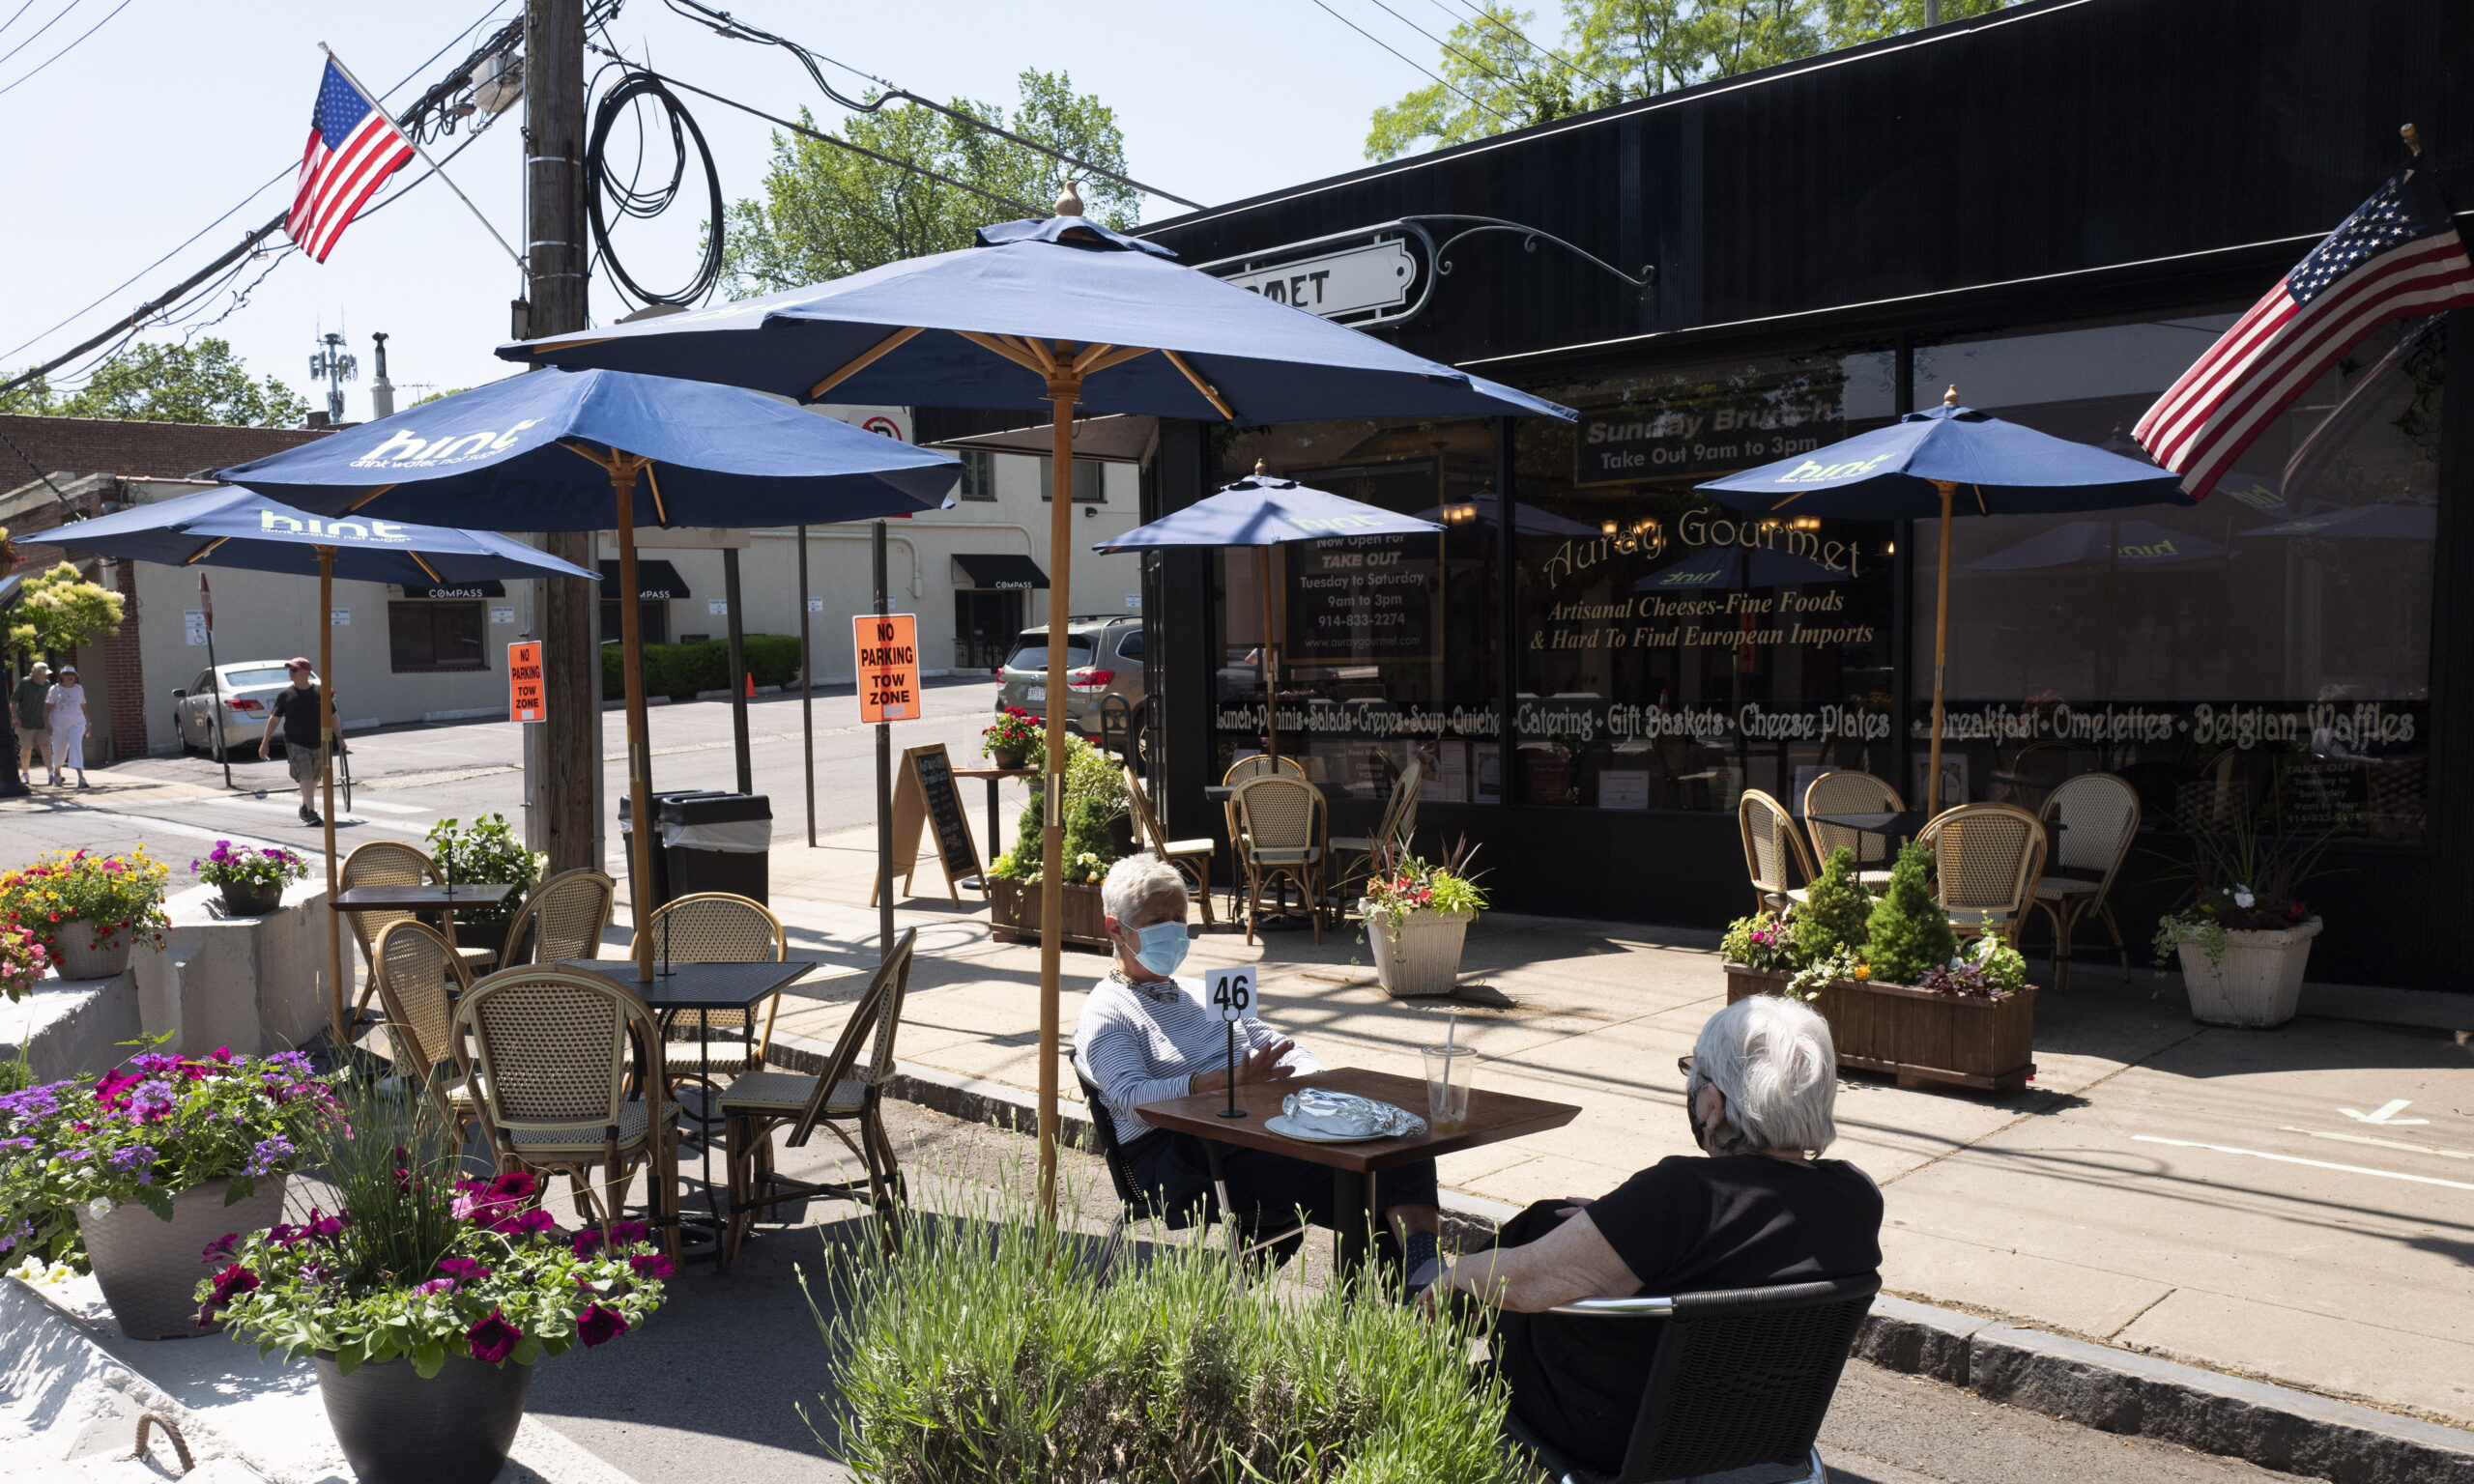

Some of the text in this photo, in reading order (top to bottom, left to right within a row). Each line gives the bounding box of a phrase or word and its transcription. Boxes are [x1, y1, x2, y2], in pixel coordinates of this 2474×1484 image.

[1586, 399, 1833, 443] Sunday Brunch
[360, 417, 545, 461] hint
[1600, 436, 1817, 470] Take Out 9am to 3pm
[1781, 453, 1895, 478] hint
[261, 510, 407, 537] hint
[261, 527, 295, 535] drink
[1289, 515, 1384, 530] hint
[1317, 537, 1344, 548] Now
[1348, 535, 1381, 548] Open
[1543, 507, 1860, 589] Auray Gourmet
[1322, 552, 1401, 568] TAKE OUT
[1300, 571, 1424, 589] Tuesday to Saturday
[429, 588, 483, 598] COMPASS
[1328, 593, 1402, 608] 9am to 3pm
[1547, 598, 1634, 621] Artisanal
[1778, 589, 1845, 613] Foods
[1318, 613, 1405, 627] 914-833-2274
[877, 623, 894, 642] NO
[1530, 622, 1875, 651] & Hard To Find European Imports
[1305, 636, 1421, 649] www.auraygourmet.com
[520, 648, 530, 663] NO
[861, 646, 913, 667] PARKING
[512, 666, 540, 680] PARKING
[872, 673, 905, 688] TOW
[517, 686, 536, 697] TOW
[870, 690, 910, 705] ZONE
[515, 698, 539, 709] ZONE
[1216, 702, 1500, 739] Lunch Pninis Salads Crepes Soup Quiche
[1517, 702, 1890, 742] Catering Gift Baskets Cheese Plates
[2053, 703, 2172, 744] Omelettes
[2194, 702, 2297, 750] Belgian
[2307, 702, 2415, 751] Waffles
[1213, 975, 1250, 1011] 46
